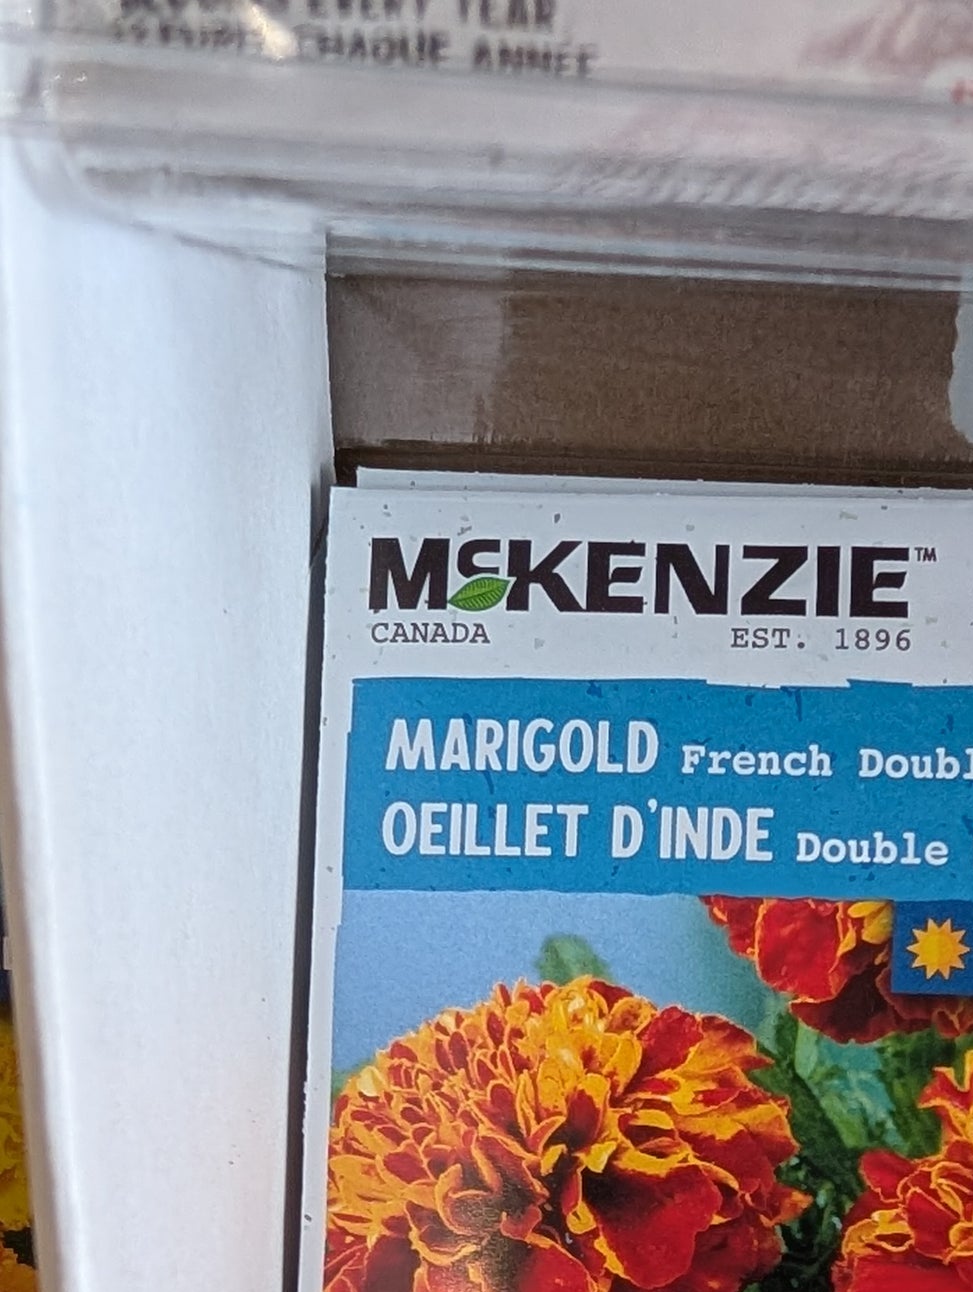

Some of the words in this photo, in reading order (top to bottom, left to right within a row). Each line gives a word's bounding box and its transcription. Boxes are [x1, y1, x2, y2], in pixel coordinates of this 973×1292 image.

[370, 622, 491, 644] CANADA
[730, 628, 806, 650] EST.
[835, 628, 912, 651] 1896
[385, 718, 659, 774] MARIGOLD
[681, 744, 833, 778] French
[381, 801, 589, 857] OEILLET
[610, 798, 774, 861] D'INDE
[796, 831, 949, 867] Double
